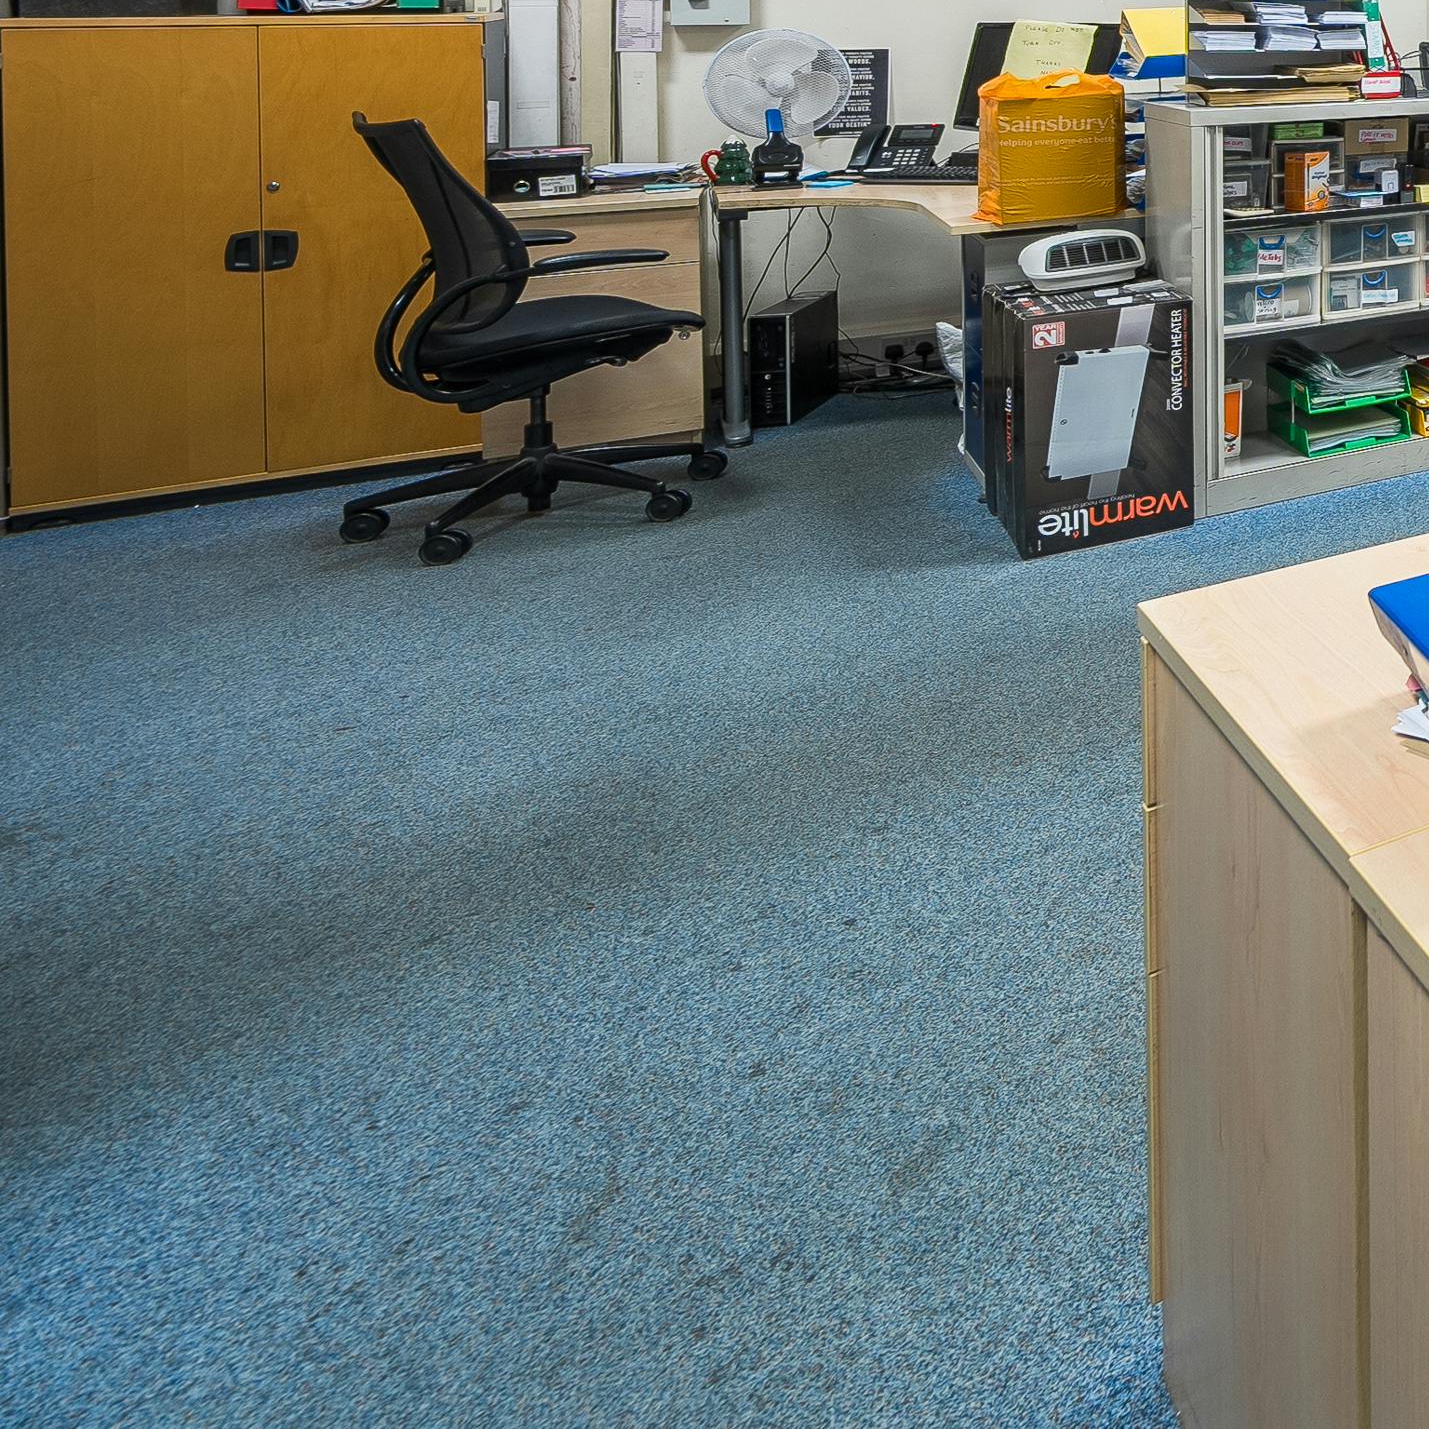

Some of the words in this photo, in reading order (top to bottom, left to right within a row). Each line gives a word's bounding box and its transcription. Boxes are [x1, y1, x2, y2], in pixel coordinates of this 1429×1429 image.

[999, 115, 1117, 134] Sainsbury's
[1171, 308, 1182, 347] HEATER
[1170, 348, 1182, 410] CONVECTOR
[1037, 490, 1189, 539] warmlite
